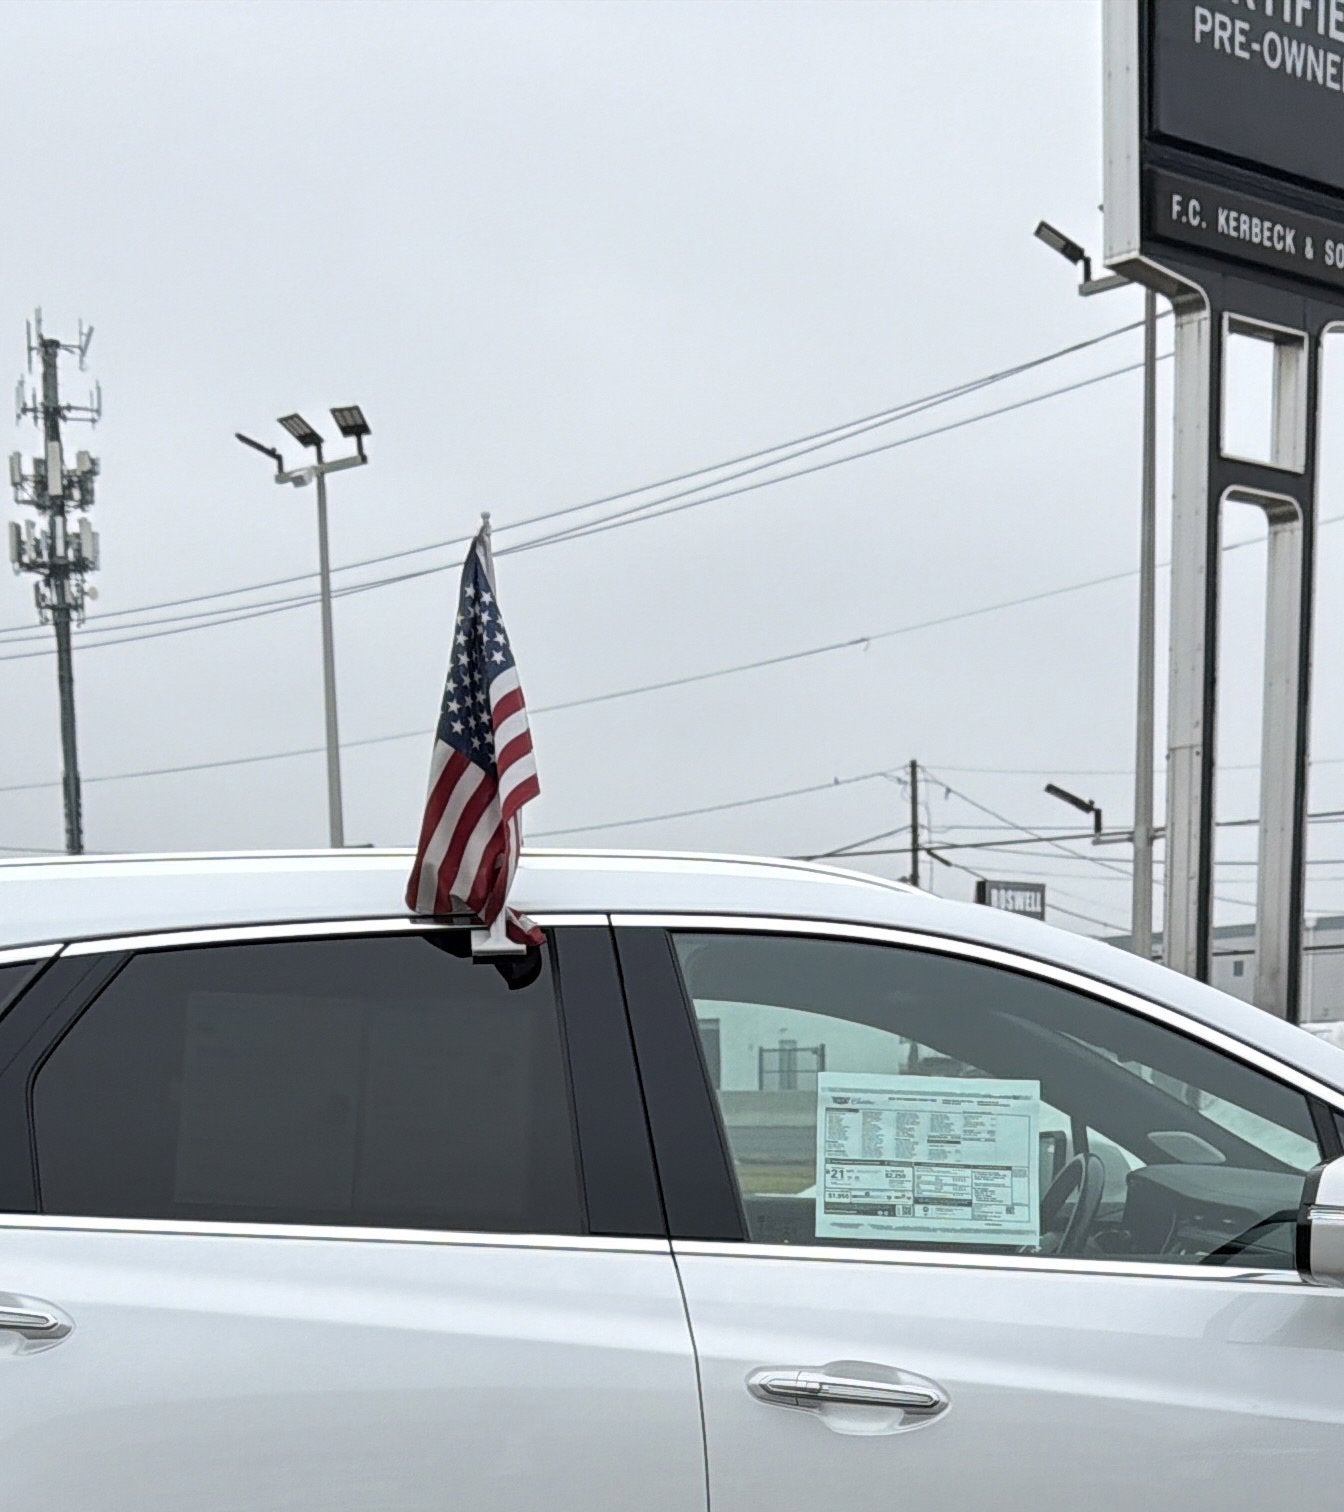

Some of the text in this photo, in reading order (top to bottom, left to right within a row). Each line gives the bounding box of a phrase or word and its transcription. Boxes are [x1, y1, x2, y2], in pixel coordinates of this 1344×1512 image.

[1171, 194, 1207, 229] F.C.
[1217, 206, 1296, 255] KERBECK
[1304, 236, 1314, 260] &
